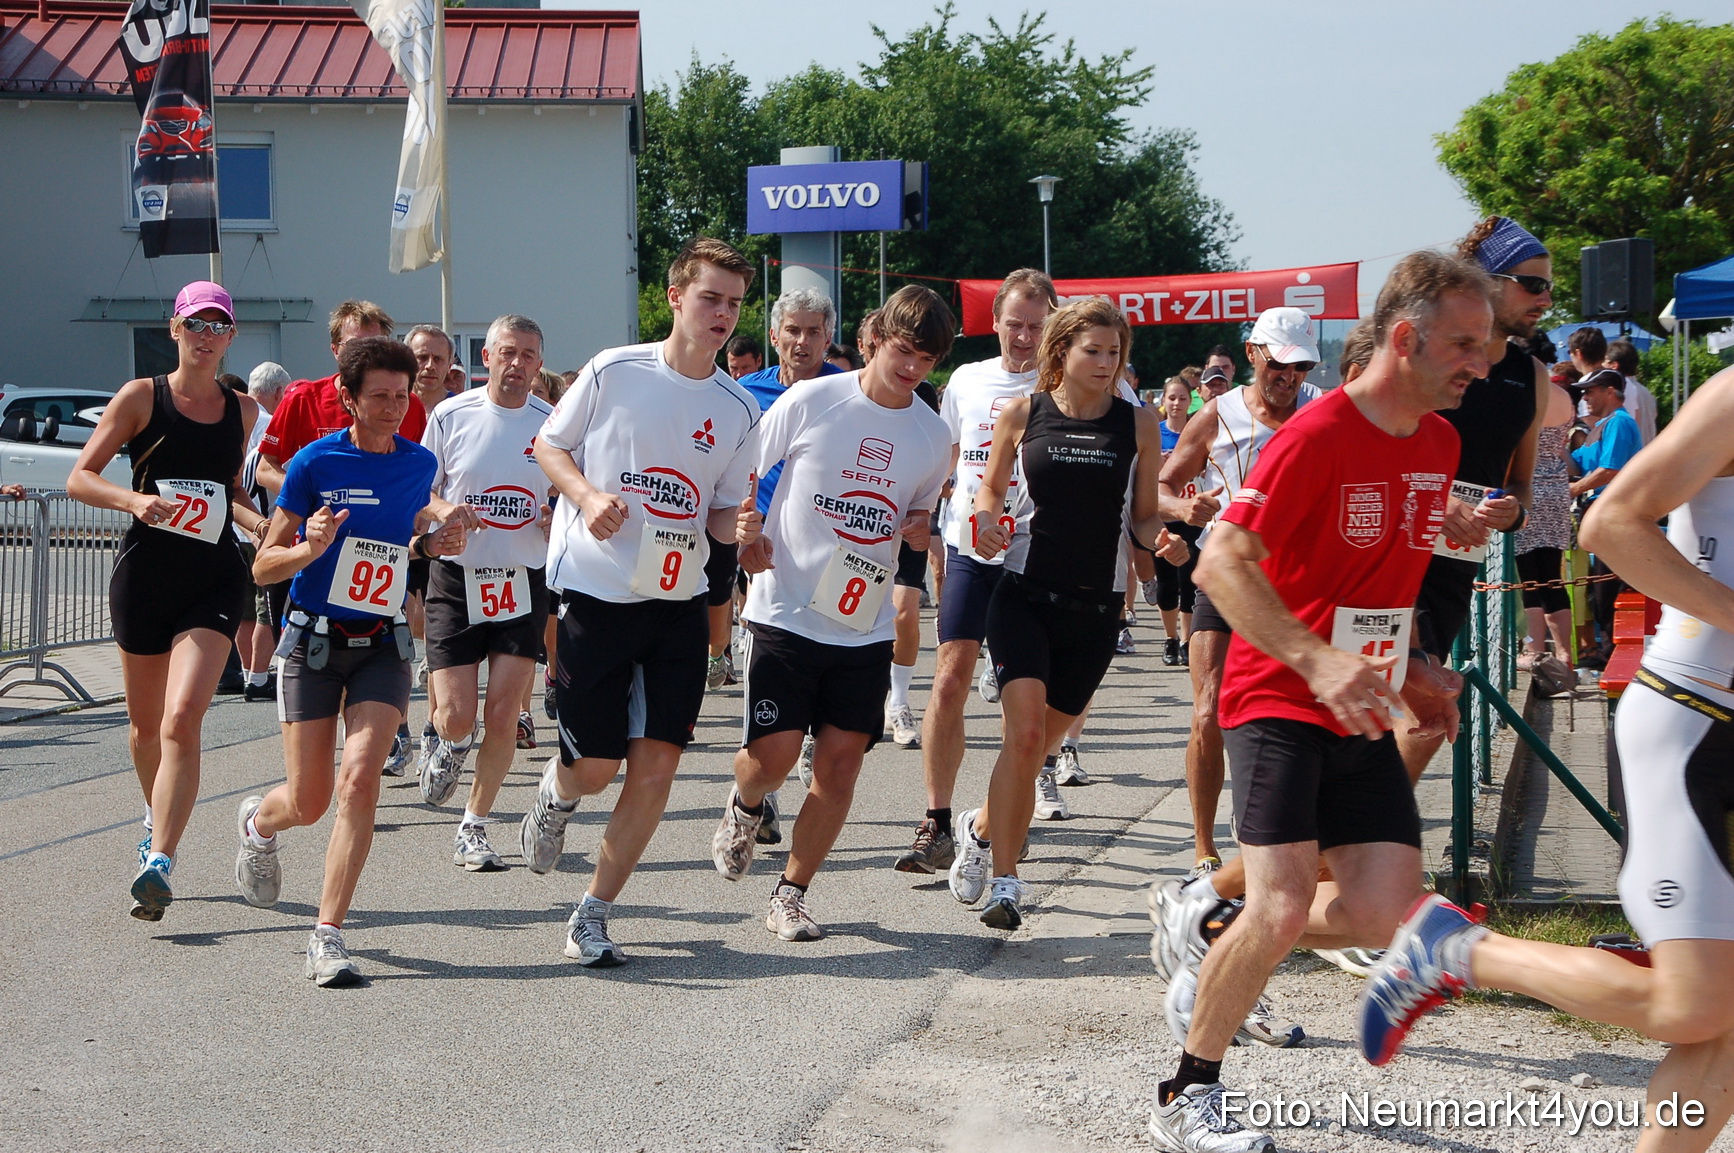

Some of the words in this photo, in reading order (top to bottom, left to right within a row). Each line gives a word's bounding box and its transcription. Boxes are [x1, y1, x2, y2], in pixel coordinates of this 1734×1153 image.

[761, 181, 880, 210] VOLVO
[1071, 447, 1117, 458] Marathon
[1052, 454, 1113, 466] Regensburg
[169, 480, 202, 488] MEYER
[620, 471, 686, 497] GERHART
[841, 469, 896, 488] SEAT
[621, 486, 652, 496] AUTOHAUS
[464, 494, 526, 507] GERHART
[650, 490, 694, 512] JÄNG
[168, 493, 209, 535] 72
[490, 506, 532, 518] JÄNIG
[813, 494, 887, 521] GERHART
[885, 513, 893, 522] &
[814, 506, 847, 521] AUTOHAUS
[844, 516, 893, 537] JÄNIG
[1346, 513, 1382, 526] NEU
[655, 529, 689, 543] MEYER
[355, 540, 388, 554] MEYER
[655, 538, 687, 549] WERBUNG
[354, 549, 387, 561] WERBUNG
[659, 550, 683, 591] 9
[843, 560, 875, 579] WERBUNG
[845, 553, 878, 574] MEYER
[475, 567, 504, 575] MEYER
[348, 560, 394, 607] 92
[480, 581, 517, 618] 54
[837, 576, 867, 616] 8
[1353, 614, 1389, 626] MEYER
[1352, 626, 1389, 635] WERBUNG
[761, 701, 769, 711] 1.
[756, 710, 776, 720] FCN
